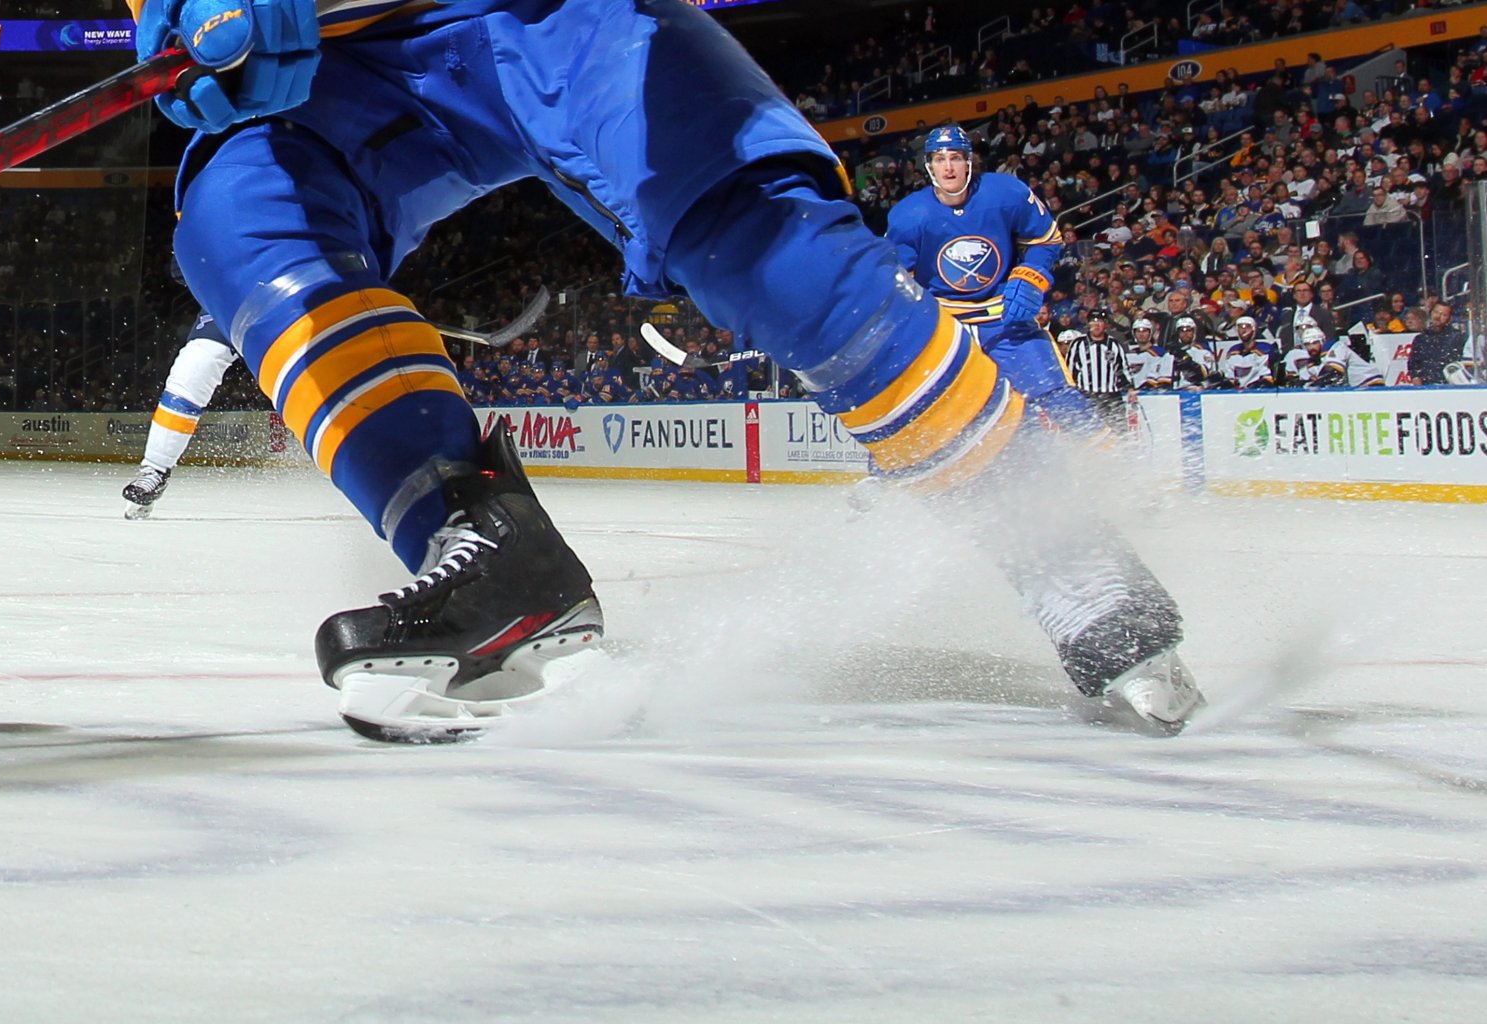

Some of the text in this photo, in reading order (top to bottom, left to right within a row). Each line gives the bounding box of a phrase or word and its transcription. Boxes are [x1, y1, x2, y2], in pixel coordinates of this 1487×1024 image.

[84, 30, 132, 39] NEW WAVE
[191, 7, 244, 46] CCM
[1177, 63, 1193, 80] 104
[869, 118, 881, 131] 103
[1028, 189, 1046, 215] 7
[21, 415, 70, 433] austin
[519, 411, 581, 452] NOVA
[631, 418, 734, 449] FANDUEL
[552, 450, 570, 459] SOLD
[836, 451, 844, 459] OF
